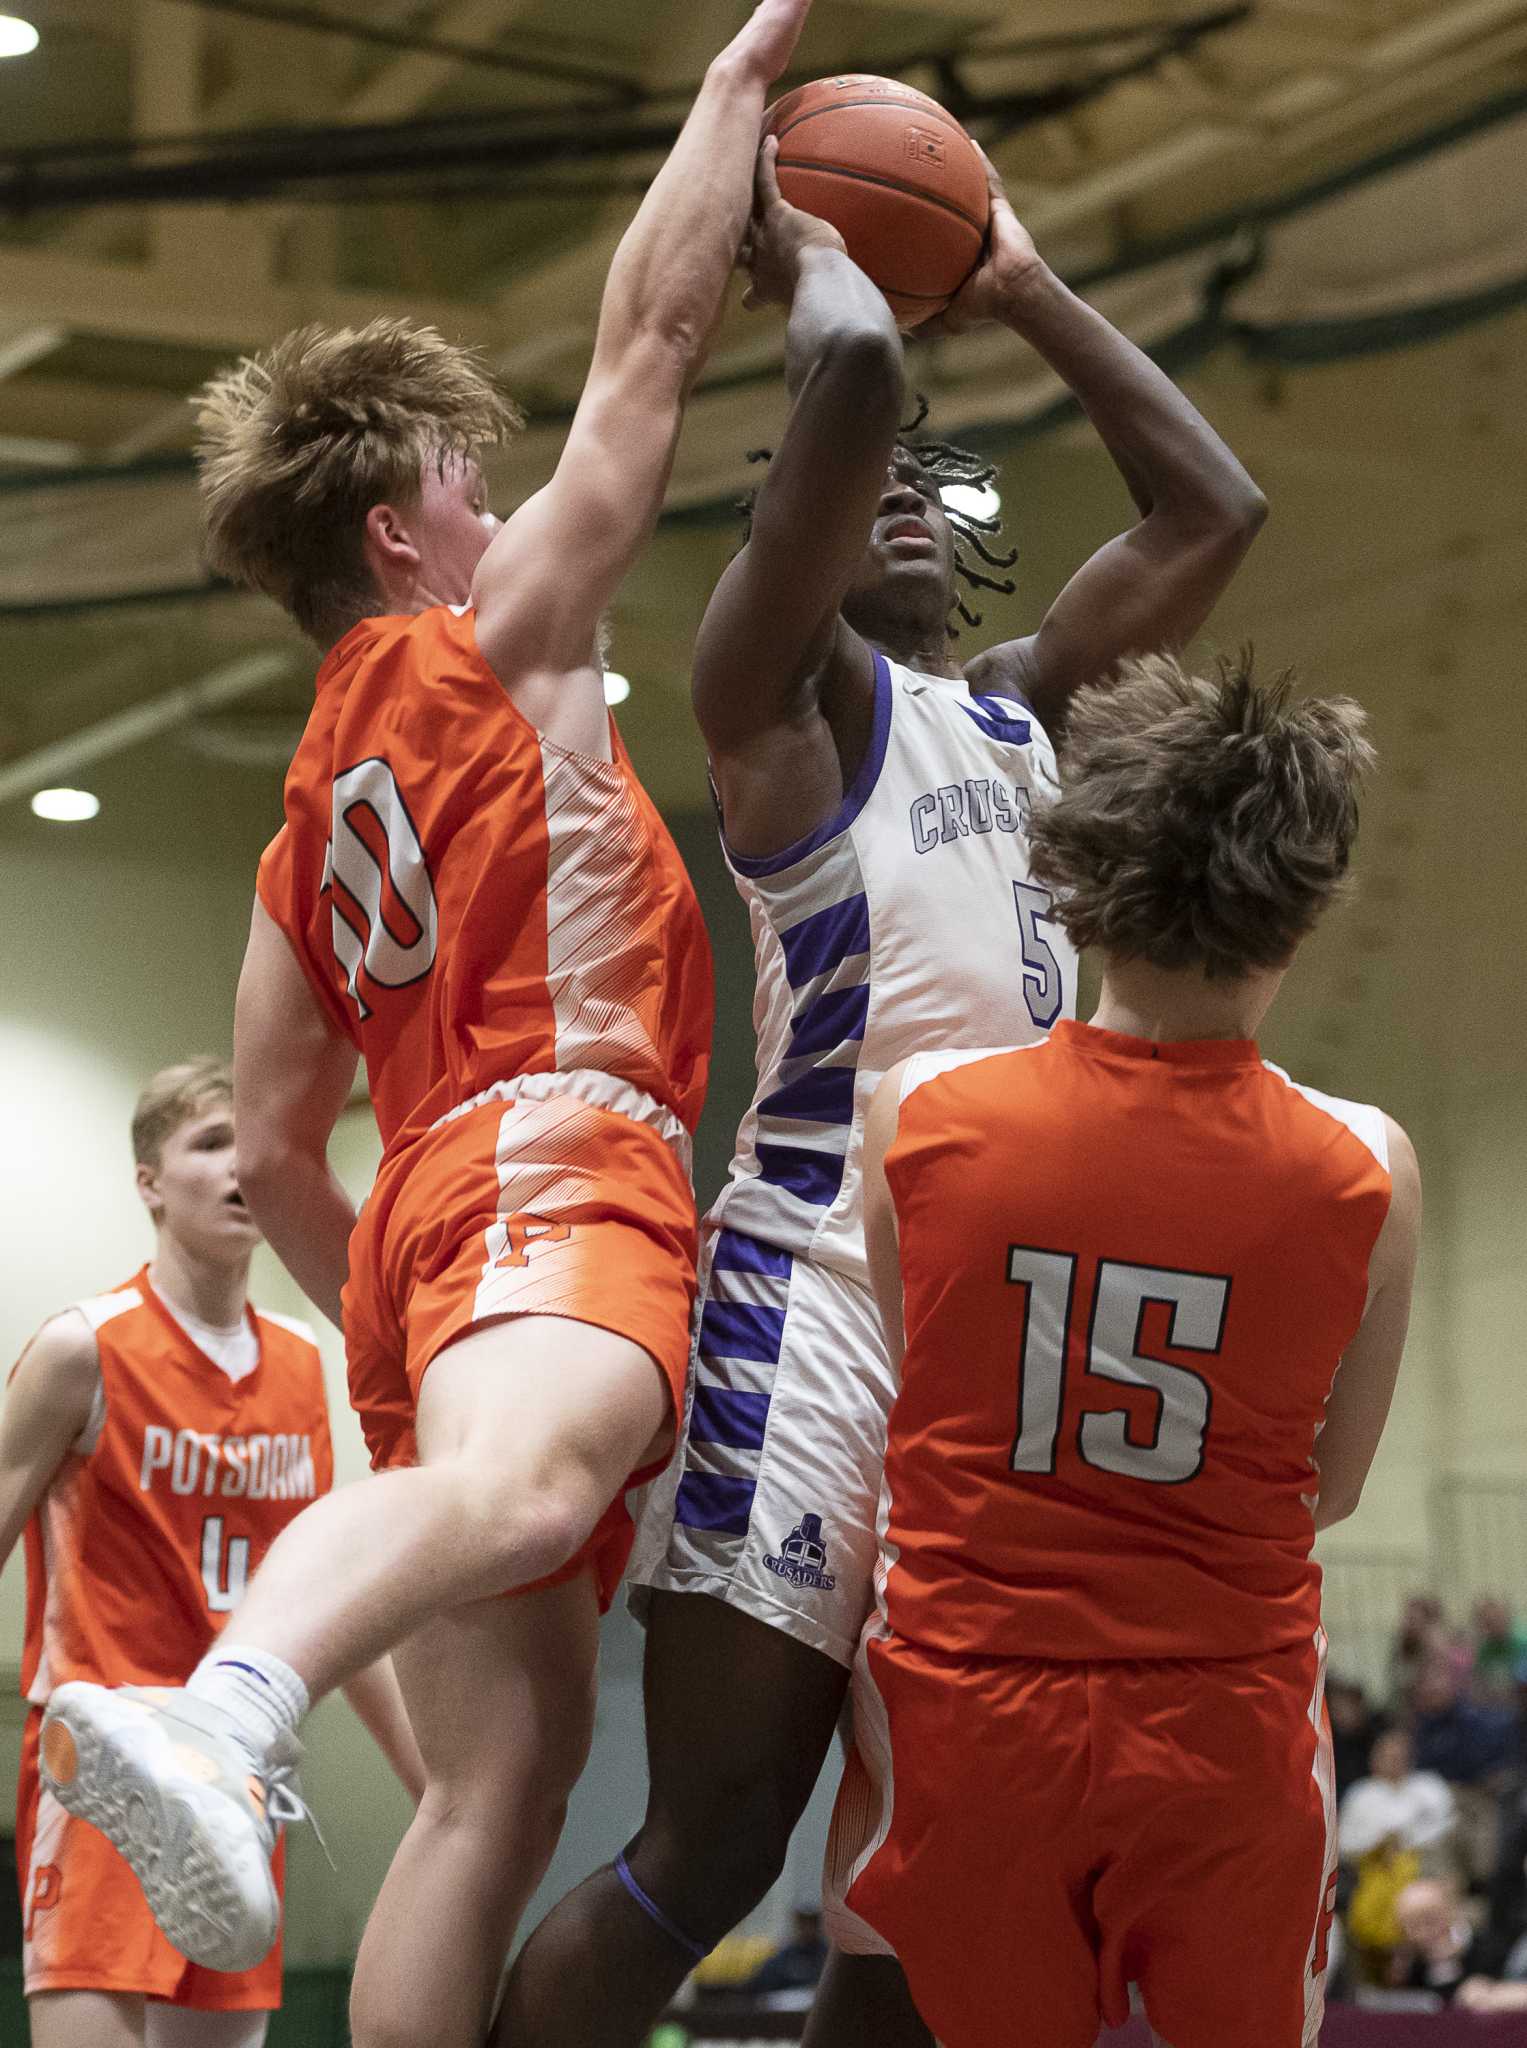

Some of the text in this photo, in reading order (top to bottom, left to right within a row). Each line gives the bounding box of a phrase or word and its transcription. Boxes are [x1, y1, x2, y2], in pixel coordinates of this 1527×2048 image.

[1012, 879, 1063, 1030] 5
[1006, 1243, 1233, 1485] 15
[139, 1425, 317, 1501] POTSDAM
[762, 1553, 836, 1590] CRUSADERS
